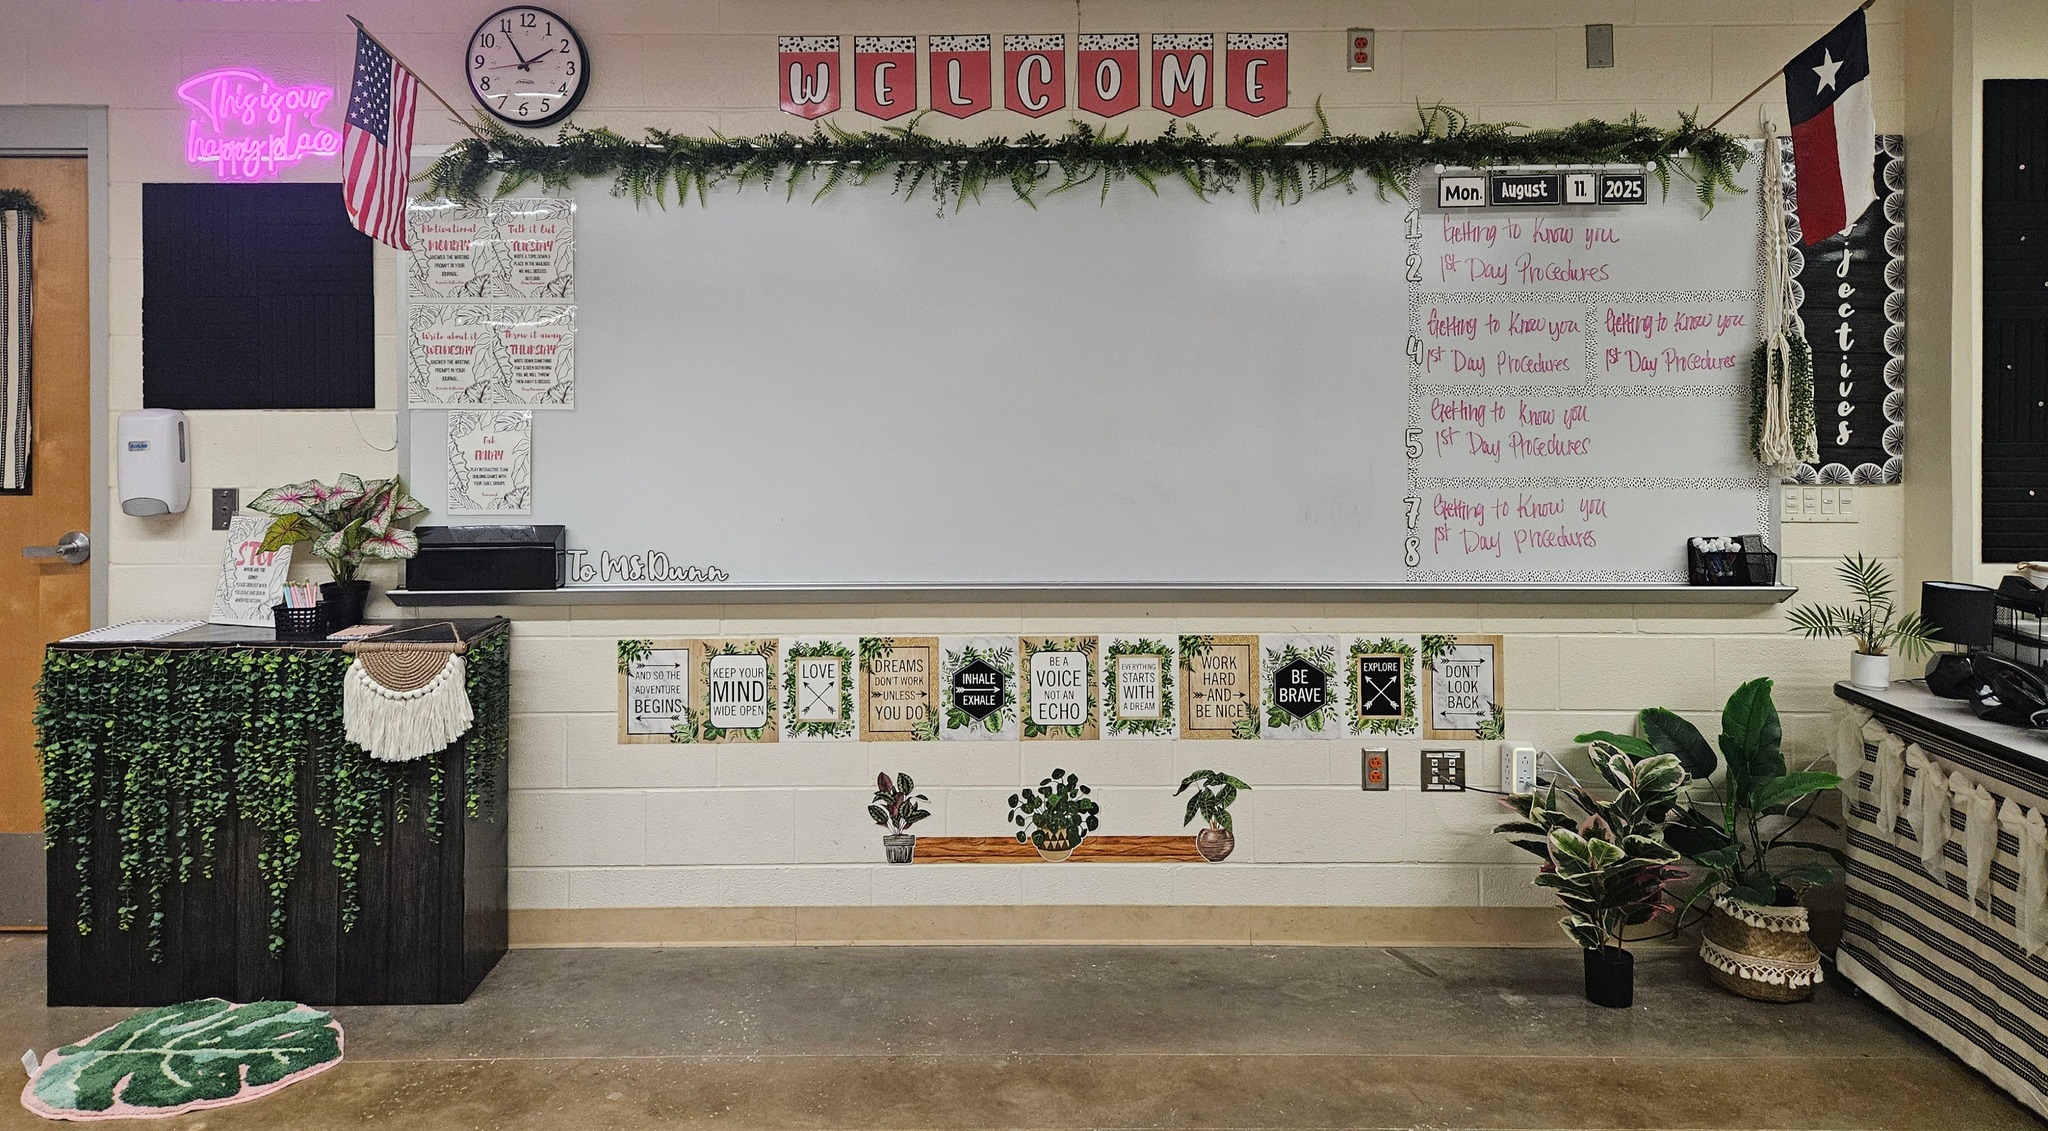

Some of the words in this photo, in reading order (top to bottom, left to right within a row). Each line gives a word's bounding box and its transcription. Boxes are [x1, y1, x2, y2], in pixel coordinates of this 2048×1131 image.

[500, 19, 512, 33] 11
[520, 13, 537, 28] 12
[545, 21, 552, 36] 1
[480, 33, 495, 48] 10
[560, 39, 570, 53] 2
[474, 55, 485, 70] 9
[566, 61, 575, 75] 3
[480, 76, 490, 91] 8
[558, 82, 568, 96] 4
[788, 53, 1269, 111] WELCOME
[178, 71, 255, 133] This
[260, 83, 284, 124] is
[286, 90, 330, 110] our
[498, 95, 508, 109] 7
[519, 102, 529, 116] 6
[540, 98, 550, 112] 5
[188, 120, 267, 177] happy
[268, 113, 338, 171] place
[1445, 184, 1483, 202] Mon.
[1501, 180, 1548, 200] August
[1574, 180, 1587, 197] 11,
[1604, 180, 1643, 199] 2025
[421, 223, 477, 234] Motivational
[529, 225, 537, 233] it
[1405, 208, 1422, 240] 1
[1443, 213, 1497, 248] Getting
[1504, 217, 1521, 240] to
[1534, 217, 1573, 243] Know
[1585, 226, 1620, 250] you
[511, 240, 553, 252] TUESDAY
[1406, 254, 1422, 282] 2
[1440, 256, 1462, 282] 1st
[1464, 257, 1508, 285] Day
[1515, 252, 1610, 284] Procedures
[1427, 308, 1477, 339] Getting
[1485, 314, 1500, 333] to
[1509, 311, 1546, 333] Know
[1548, 318, 1581, 341] you
[1604, 308, 1654, 339] Getting
[1654, 312, 1669, 332] to
[1673, 310, 1712, 332] Know
[1716, 312, 1747, 338] you
[471, 332, 477, 340] it
[426, 345, 474, 355] WEDNESDAY
[510, 344, 556, 355] THURSDAY
[1405, 335, 1423, 365] 4
[1426, 348, 1447, 373] 1st
[1451, 349, 1486, 377] Day
[1497, 351, 1570, 377] Procedures
[1605, 348, 1622, 373] 1st
[1624, 349, 1658, 377] Day
[1661, 348, 1737, 372] Procedures
[1431, 397, 1486, 427] Getting
[1492, 400, 1506, 420] to
[1518, 399, 1555, 427] Know
[1563, 404, 1590, 430] you
[1405, 428, 1423, 459] 5
[1435, 426, 1461, 458] 1st
[1466, 432, 1501, 463] Day
[1509, 430, 1591, 459] Procedures
[1403, 497, 1421, 529] 7
[1433, 492, 1485, 526] Getting
[1492, 501, 1509, 520] to
[1517, 497, 1564, 519] Know
[1580, 497, 1608, 522] you
[1434, 524, 1452, 553] 1st
[1460, 529, 1501, 558] Day
[1405, 536, 1421, 567] 8
[567, 550, 597, 582] To
[648, 550, 729, 582] Dunn
[875, 659, 924, 673] DREAMS
[1049, 657, 1060, 666] BE
[1063, 657, 1069, 666] A
[1201, 656, 1237, 670] WORK
[1363, 662, 1398, 672] EXPLORE
[635, 671, 651, 680] AND
[654, 671, 664, 680] SO
[666, 671, 681, 680] THE
[713, 668, 736, 678] KEEP
[739, 668, 764, 678] YOUR
[802, 664, 835, 679] LOVE
[1036, 670, 1081, 687] VOICE
[1122, 673, 1155, 683] STARTS
[1291, 669, 1309, 684] BE
[1445, 665, 1480, 678] DON'T
[875, 677, 898, 686] DON'T
[900, 677, 924, 686] WORK
[962, 673, 996, 685] INHALE
[1203, 672, 1236, 686] HARD
[635, 685, 681, 694] ADVENTURE
[713, 681, 764, 703] MIND
[1123, 685, 1154, 699] WITH
[1448, 681, 1479, 693] LOOK
[883, 691, 916, 701] UNLESS
[963, 695, 996, 706] EXHALE
[1044, 691, 1060, 700] NOT
[1063, 691, 1074, 700] AN
[1207, 688, 1232, 702] AND
[1280, 687, 1322, 703] BRAVE
[635, 699, 682, 714] BEGINS
[1123, 702, 1128, 711] A
[1130, 702, 1155, 711] DREAM
[1448, 696, 1480, 709] BACK
[713, 706, 736, 716] WIDE
[740, 706, 764, 716] OPEN
[875, 706, 901, 720] YOU
[906, 706, 923, 720] DO
[1039, 703, 1080, 720] ECHO
[1196, 704, 1212, 718] BE
[1216, 704, 1244, 718] NICE
